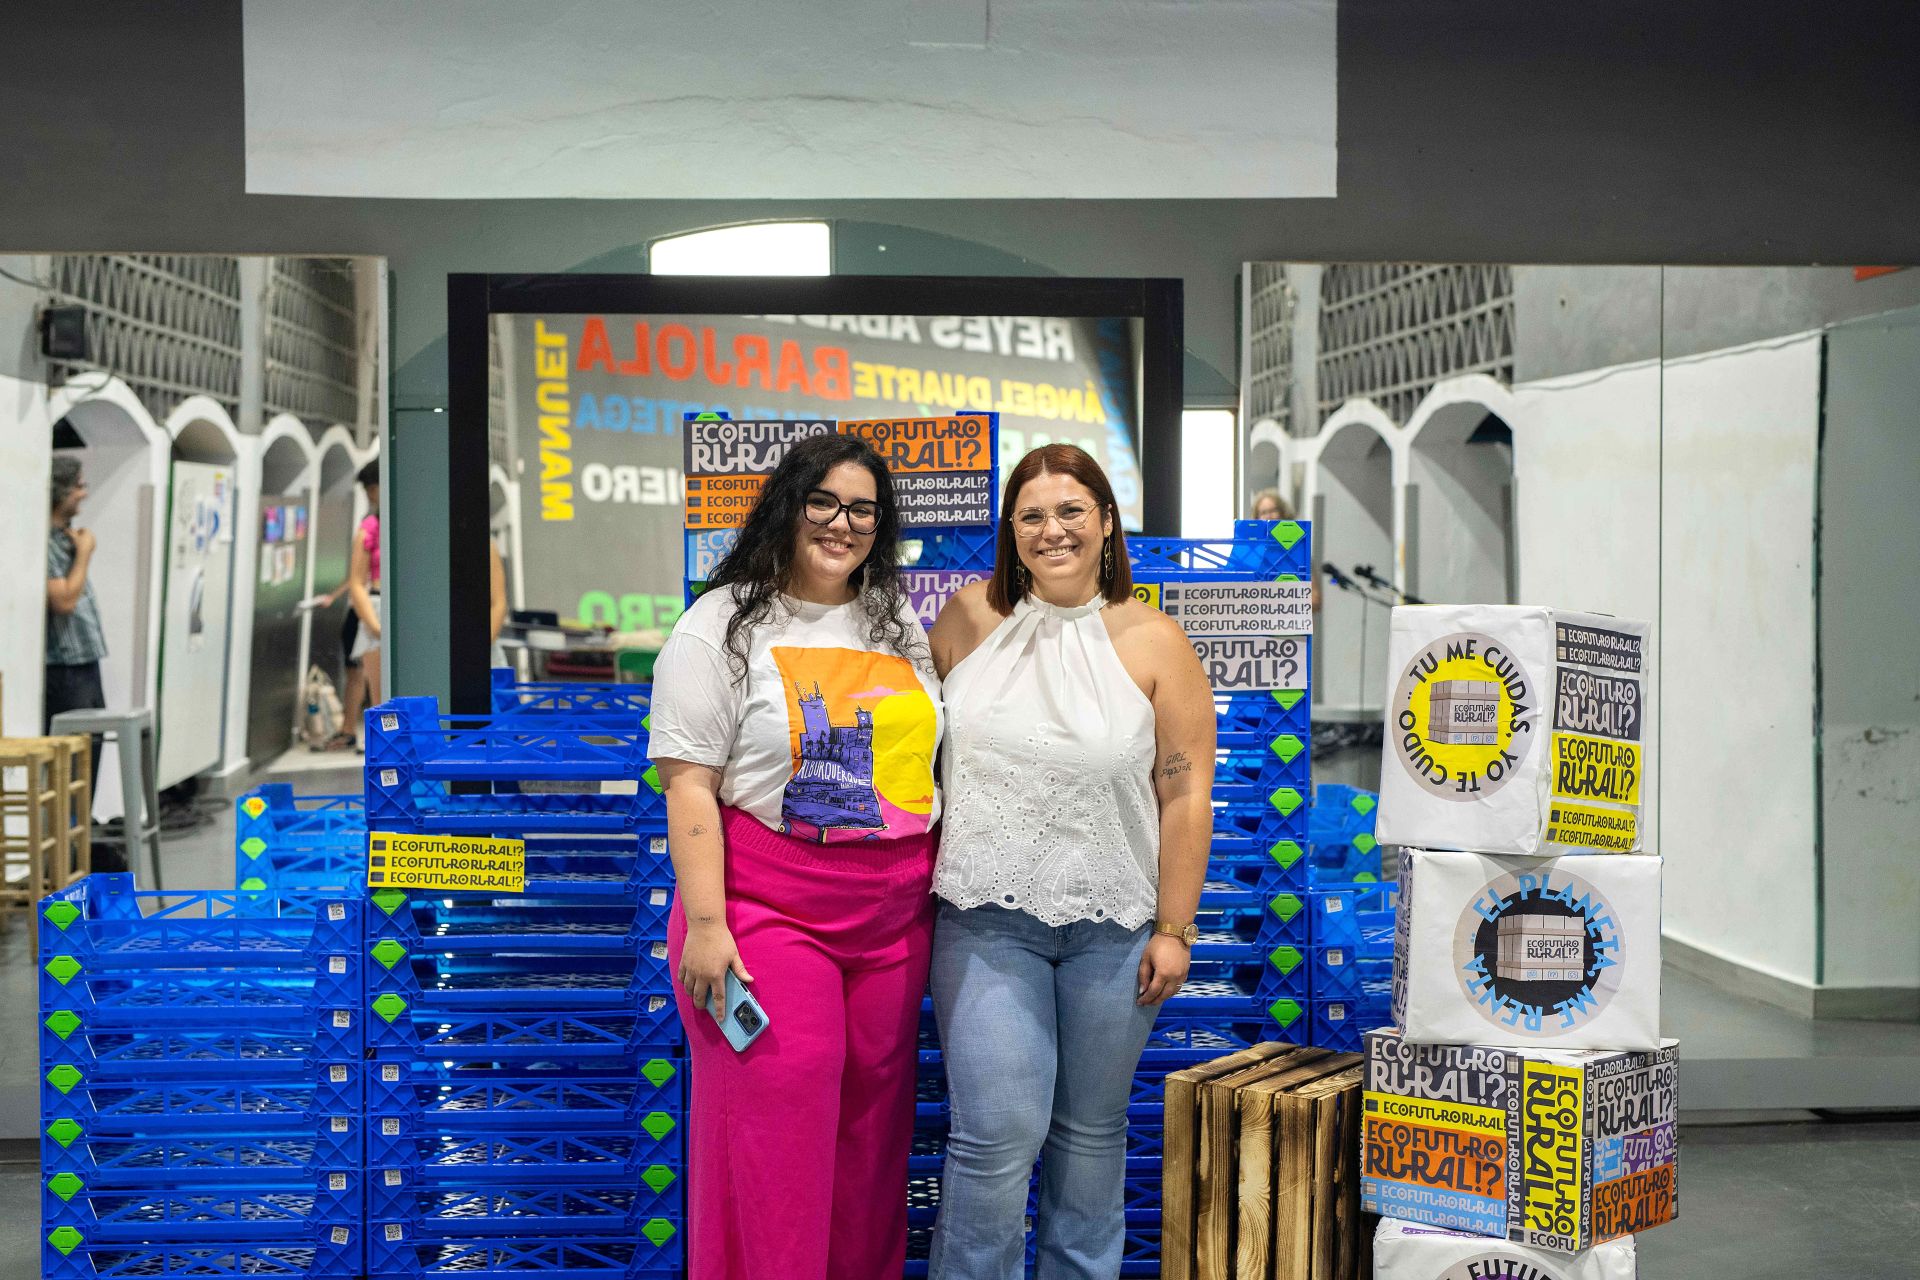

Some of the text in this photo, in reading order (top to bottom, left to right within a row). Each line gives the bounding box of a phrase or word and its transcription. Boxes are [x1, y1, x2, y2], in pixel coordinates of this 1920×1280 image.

[1409, 651, 1439, 683] TU
[1446, 639, 1477, 663] ME
[1399, 709, 1448, 785] CUIDO
[1487, 750, 1518, 781] YO
[1456, 771, 1481, 792] TE
[1472, 887, 1514, 923] EL
[1462, 953, 1543, 1032] RENTA
[1553, 985, 1599, 1029] ME
[1370, 1060, 1506, 1108] RURAL!?
[1366, 1143, 1501, 1196] RURAL!?
